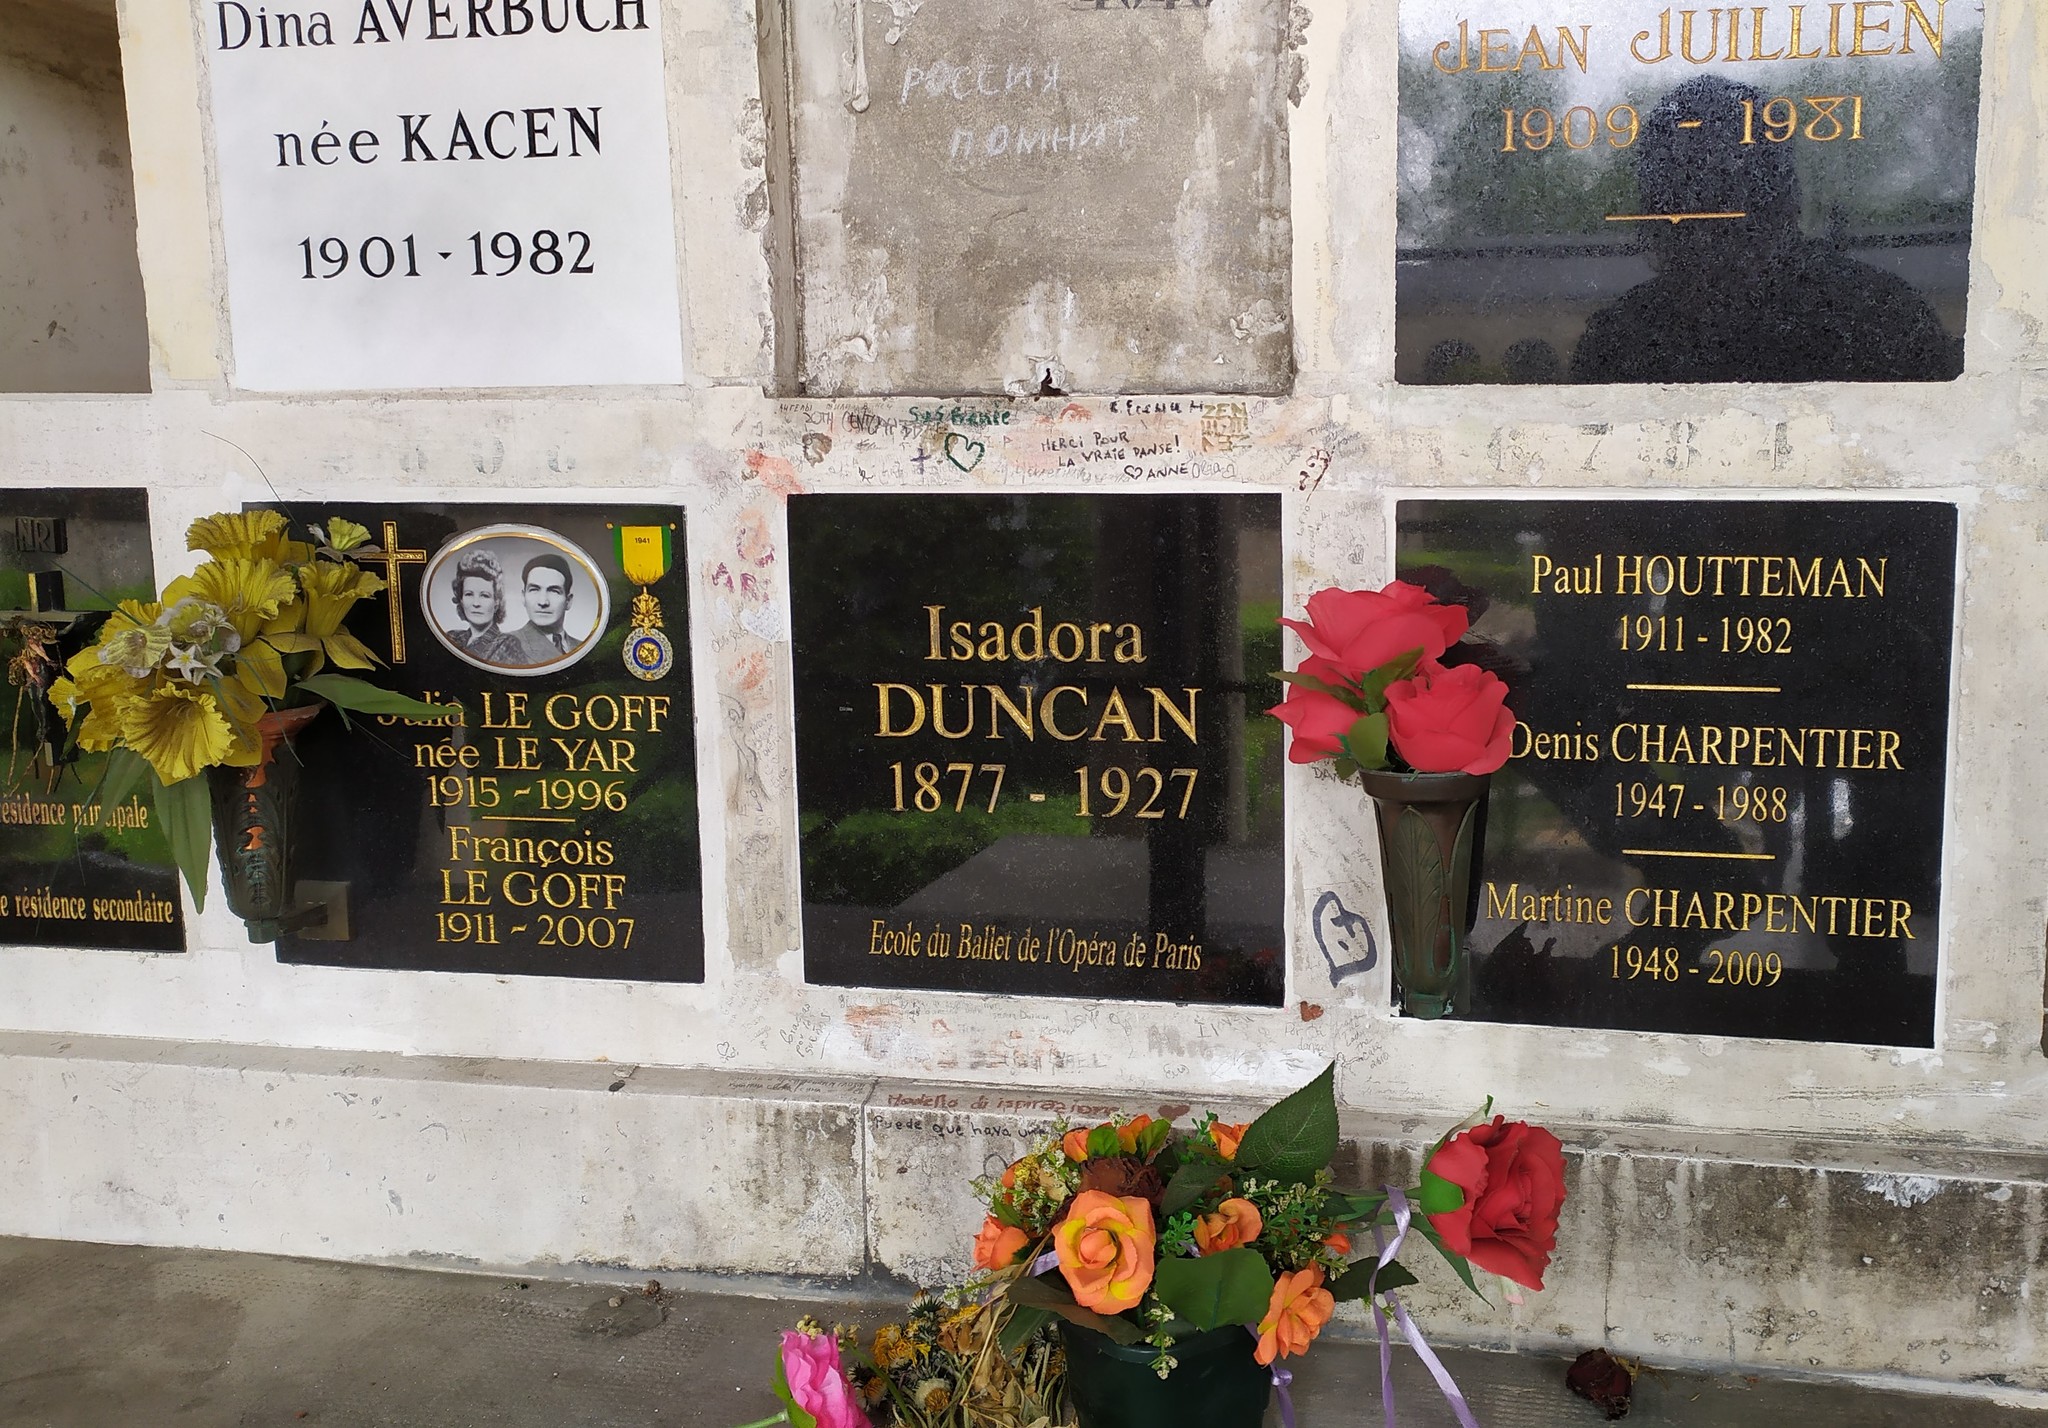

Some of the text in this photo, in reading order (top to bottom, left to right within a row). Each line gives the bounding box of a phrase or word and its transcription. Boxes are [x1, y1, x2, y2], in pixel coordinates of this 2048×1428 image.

[217, 0, 650, 51] Dina AVERBUCH
[1432, 0, 1947, 75] JEAN JUILLIEN
[273, 106, 603, 167] née KACEN
[1500, 104, 1641, 154] 1909
[1738, 95, 1865, 146] 1981
[298, 235, 420, 279] 1901
[467, 230, 595, 276] 1982
[1531, 554, 1889, 598] Paul HOUTTEMAN
[923, 605, 1148, 664] Isadora
[1619, 615, 1685, 653] 1911
[1720, 616, 1793, 654] 1982
[480, 692, 532, 729] LE
[545, 693, 671, 733] GOFF
[871, 682, 1202, 745] DUNCAN
[414, 736, 639, 773] née LE YAR
[1509, 720, 1905, 771] Denis CHARPENTIER
[0, 793, 66, 826] ésidence
[426, 775, 501, 808] 1915
[536, 778, 628, 812] 1996
[889, 761, 1006, 813] 1877
[1073, 765, 1199, 819] 1927
[1614, 781, 1685, 819] 1947
[1716, 785, 1788, 823] 1988
[447, 825, 614, 868] François
[15, 886, 87, 920] résidence
[93, 889, 174, 923] secondaire
[439, 868, 627, 910] LE GOFF
[1485, 881, 1916, 940] Martine CHARPENTIER
[435, 912, 501, 944] 1911
[537, 914, 636, 949] 2007
[869, 919, 1202, 973] Ecole du Ballet de l'Opéra de Paris
[1610, 944, 1680, 982] 1948
[1707, 949, 1782, 987] 2009
[874, 1114, 923, 1132] Puede
